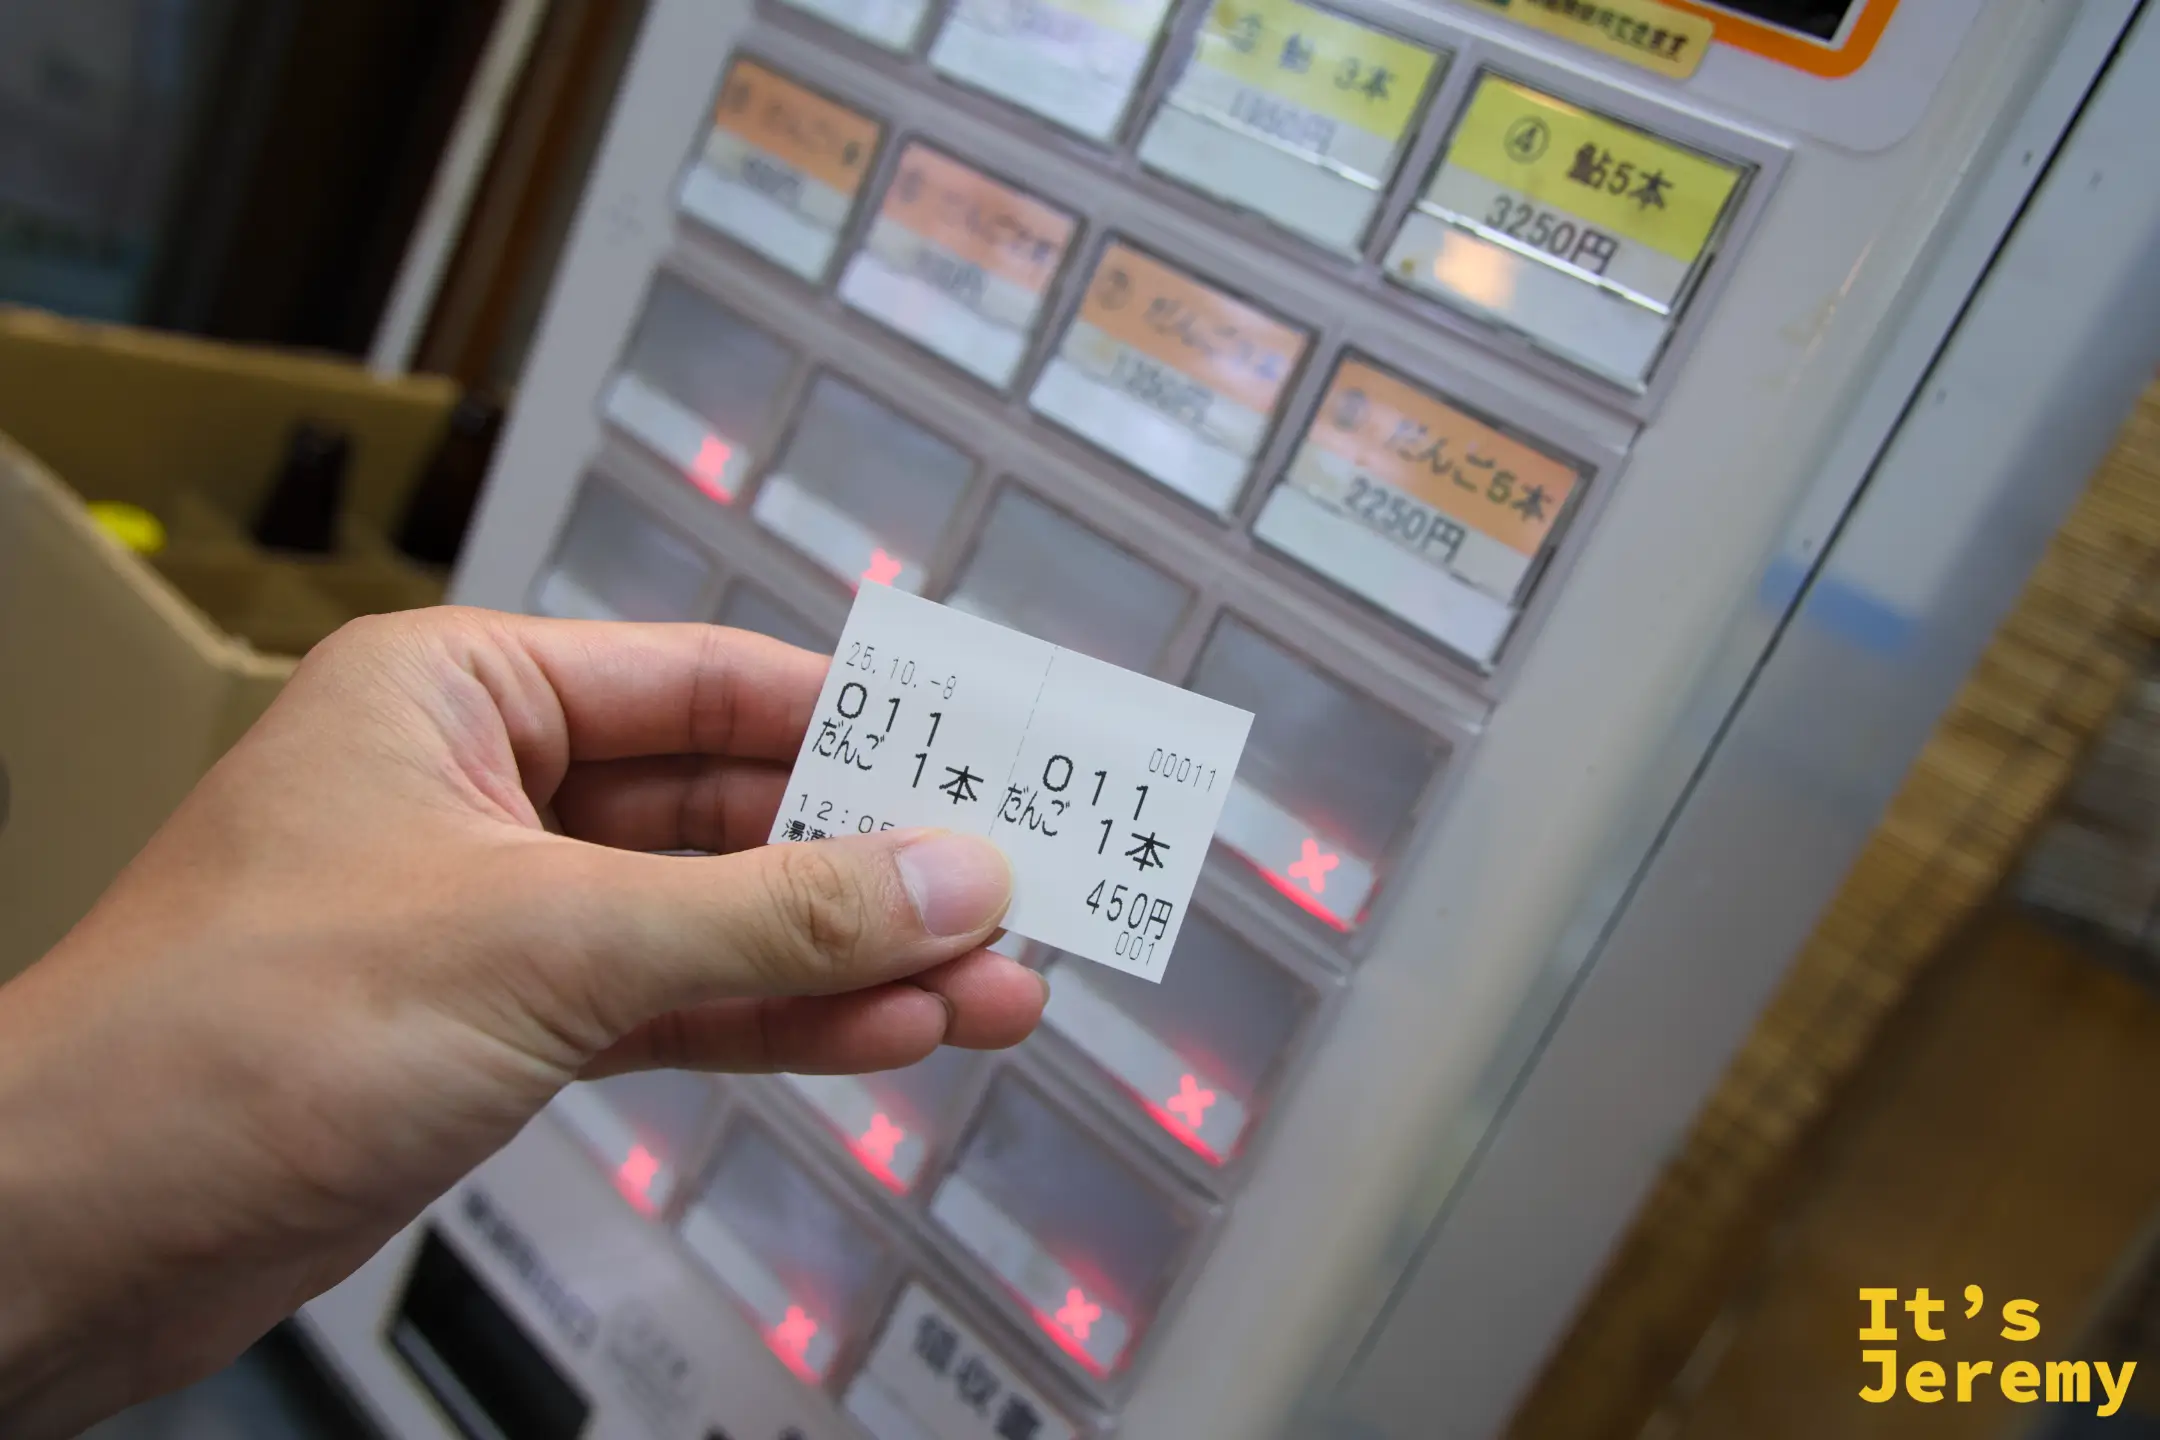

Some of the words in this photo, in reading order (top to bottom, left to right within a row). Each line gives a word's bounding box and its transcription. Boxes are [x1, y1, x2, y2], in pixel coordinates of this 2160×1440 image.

[1567, 141, 1675, 211] 鮎5本
[1485, 194, 1620, 277] 3250円
[1383, 418, 1557, 523] だんご5本
[1343, 476, 1466, 563] 2250円
[836, 681, 942, 748] 011
[811, 717, 886, 771] だんご
[911, 752, 985, 805] 1本
[1043, 754, 1148, 821] 011
[1149, 748, 1216, 792] 00011
[781, 818, 833, 842] 湯滝
[997, 782, 1071, 837] だんご
[1097, 819, 1171, 872] 1本
[1086, 879, 1173, 940] 450円
[1114, 931, 1155, 966] 001
